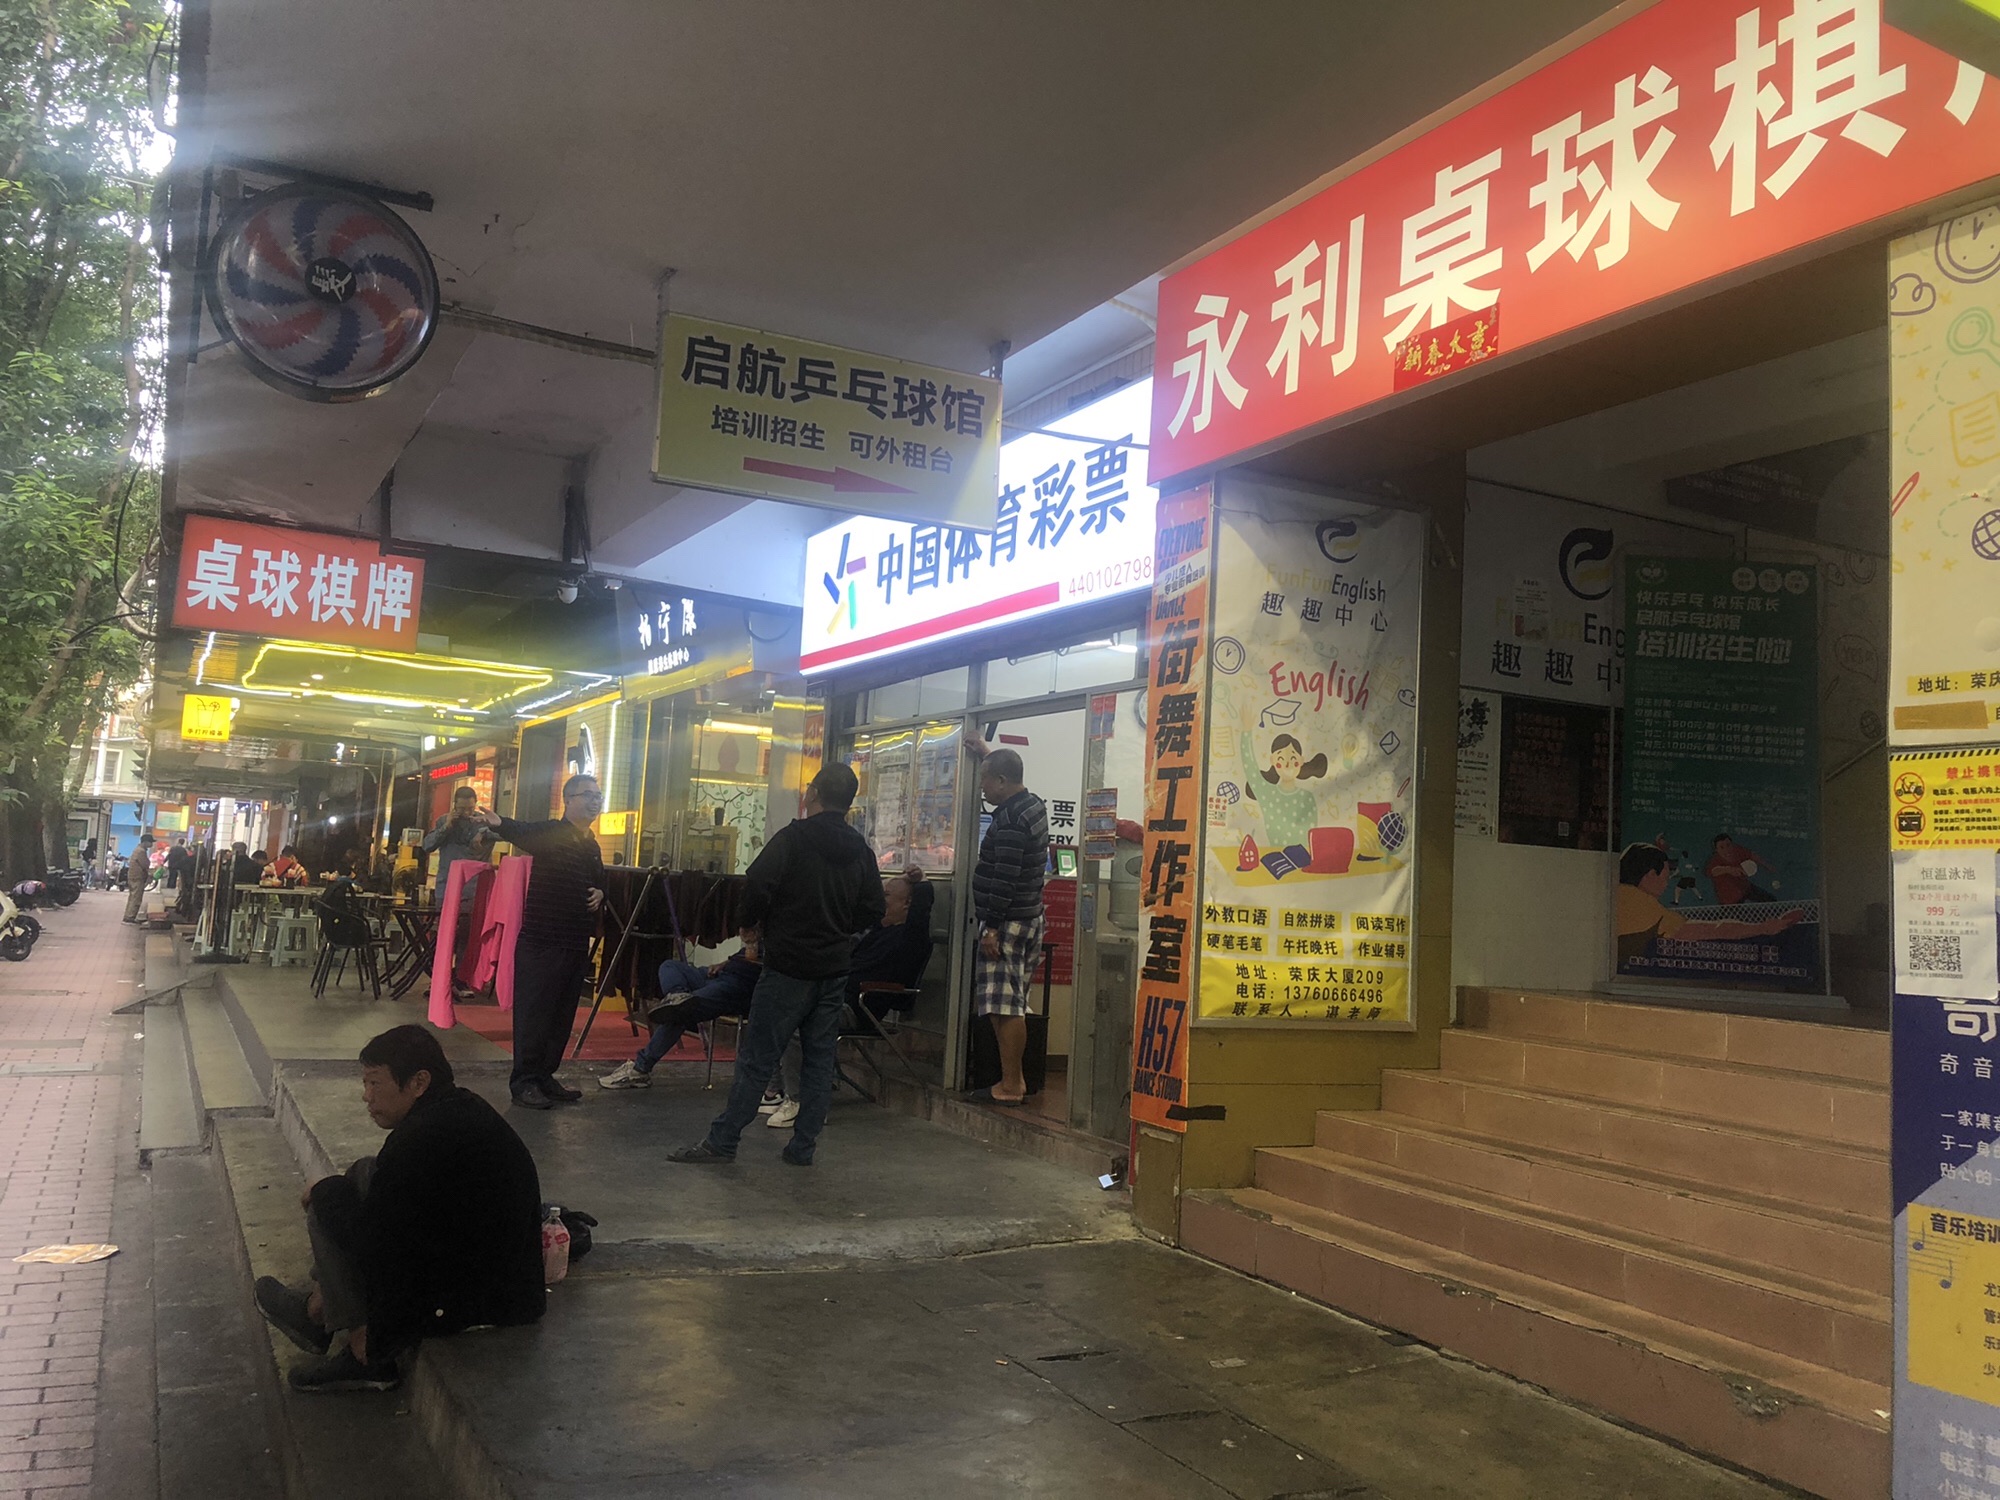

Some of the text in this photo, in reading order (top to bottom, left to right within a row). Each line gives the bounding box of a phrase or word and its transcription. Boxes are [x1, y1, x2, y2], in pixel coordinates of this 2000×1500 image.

[1167, 0, 1987, 439] 永利桌球棋
[1401, 319, 1490, 374] 新春大吉
[682, 336, 985, 438] 启航乒乓球馆
[711, 404, 954, 475] 培训招生 可外租台
[877, 433, 1133, 605] 中国体育彩票
[1157, 517, 1207, 560] EVERYONE
[187, 538, 414, 632] 桌球棋牌
[1636, 590, 1780, 612] 快乐乒乓 快乐成长
[1260, 590, 1388, 633] 趣趣中心
[1635, 610, 1742, 631] 启航乒乓球馆
[1269, 660, 1370, 713] English
[1142, 618, 1201, 985] 街舞工作室
[1921, 867, 1976, 880] 恒温泳池
[1205, 906, 1407, 932] 外教口语 自然拼读 阅读写作
[1926, 906, 1960, 917] 999 元
[1206, 933, 1406, 958] 硬笔毛笔 午托晚托 作业辅导
[1137, 995, 1186, 1074] H57
[1133, 1068, 1183, 1103] DANCE STUDIO
[1930, 1213, 2000, 1244] 音乐培训
[1984, 1282, 2000, 1298] 尤
[1984, 1307, 2000, 1324] 管
[1984, 1336, 2000, 1350] 乐
[1983, 1362, 2000, 1378] 少
